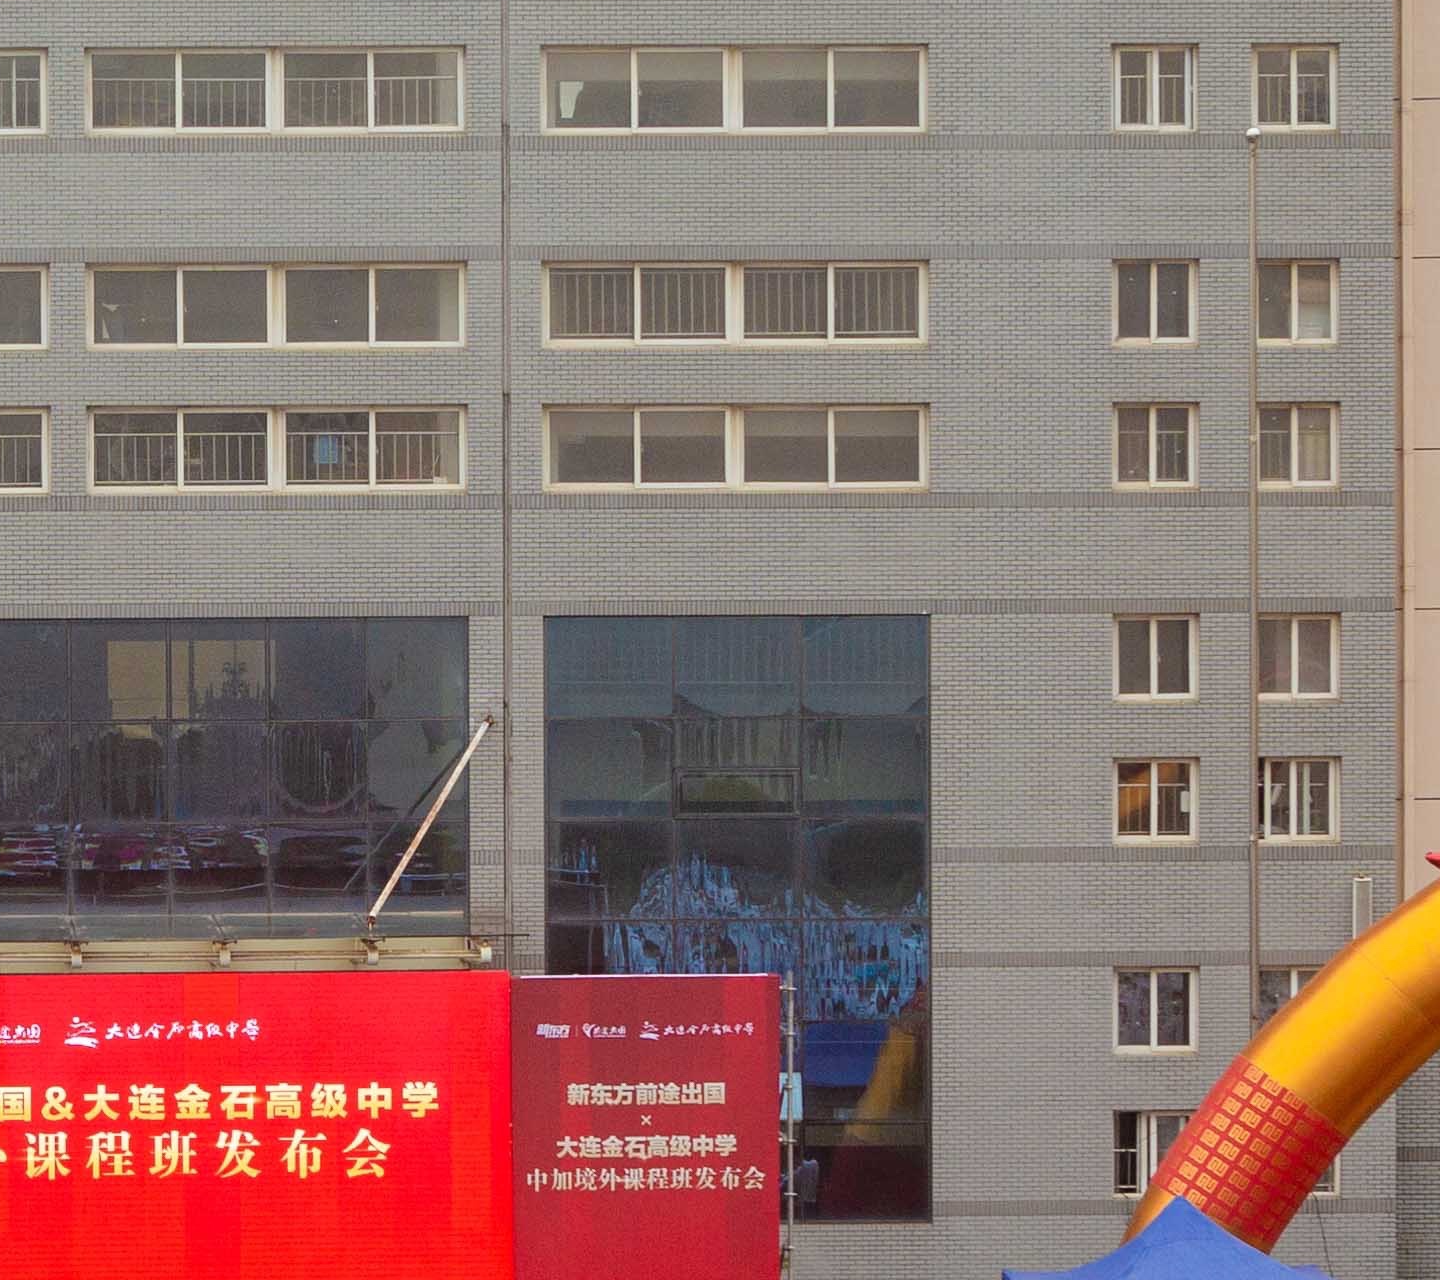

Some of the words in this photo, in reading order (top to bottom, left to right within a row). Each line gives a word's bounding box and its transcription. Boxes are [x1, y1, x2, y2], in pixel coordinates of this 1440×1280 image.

[567, 1081, 726, 1105] 新东方前途出国
[556, 1133, 737, 1159] 大连金石高级中学
[526, 1166, 766, 1192] 中加境外课程班发布会
